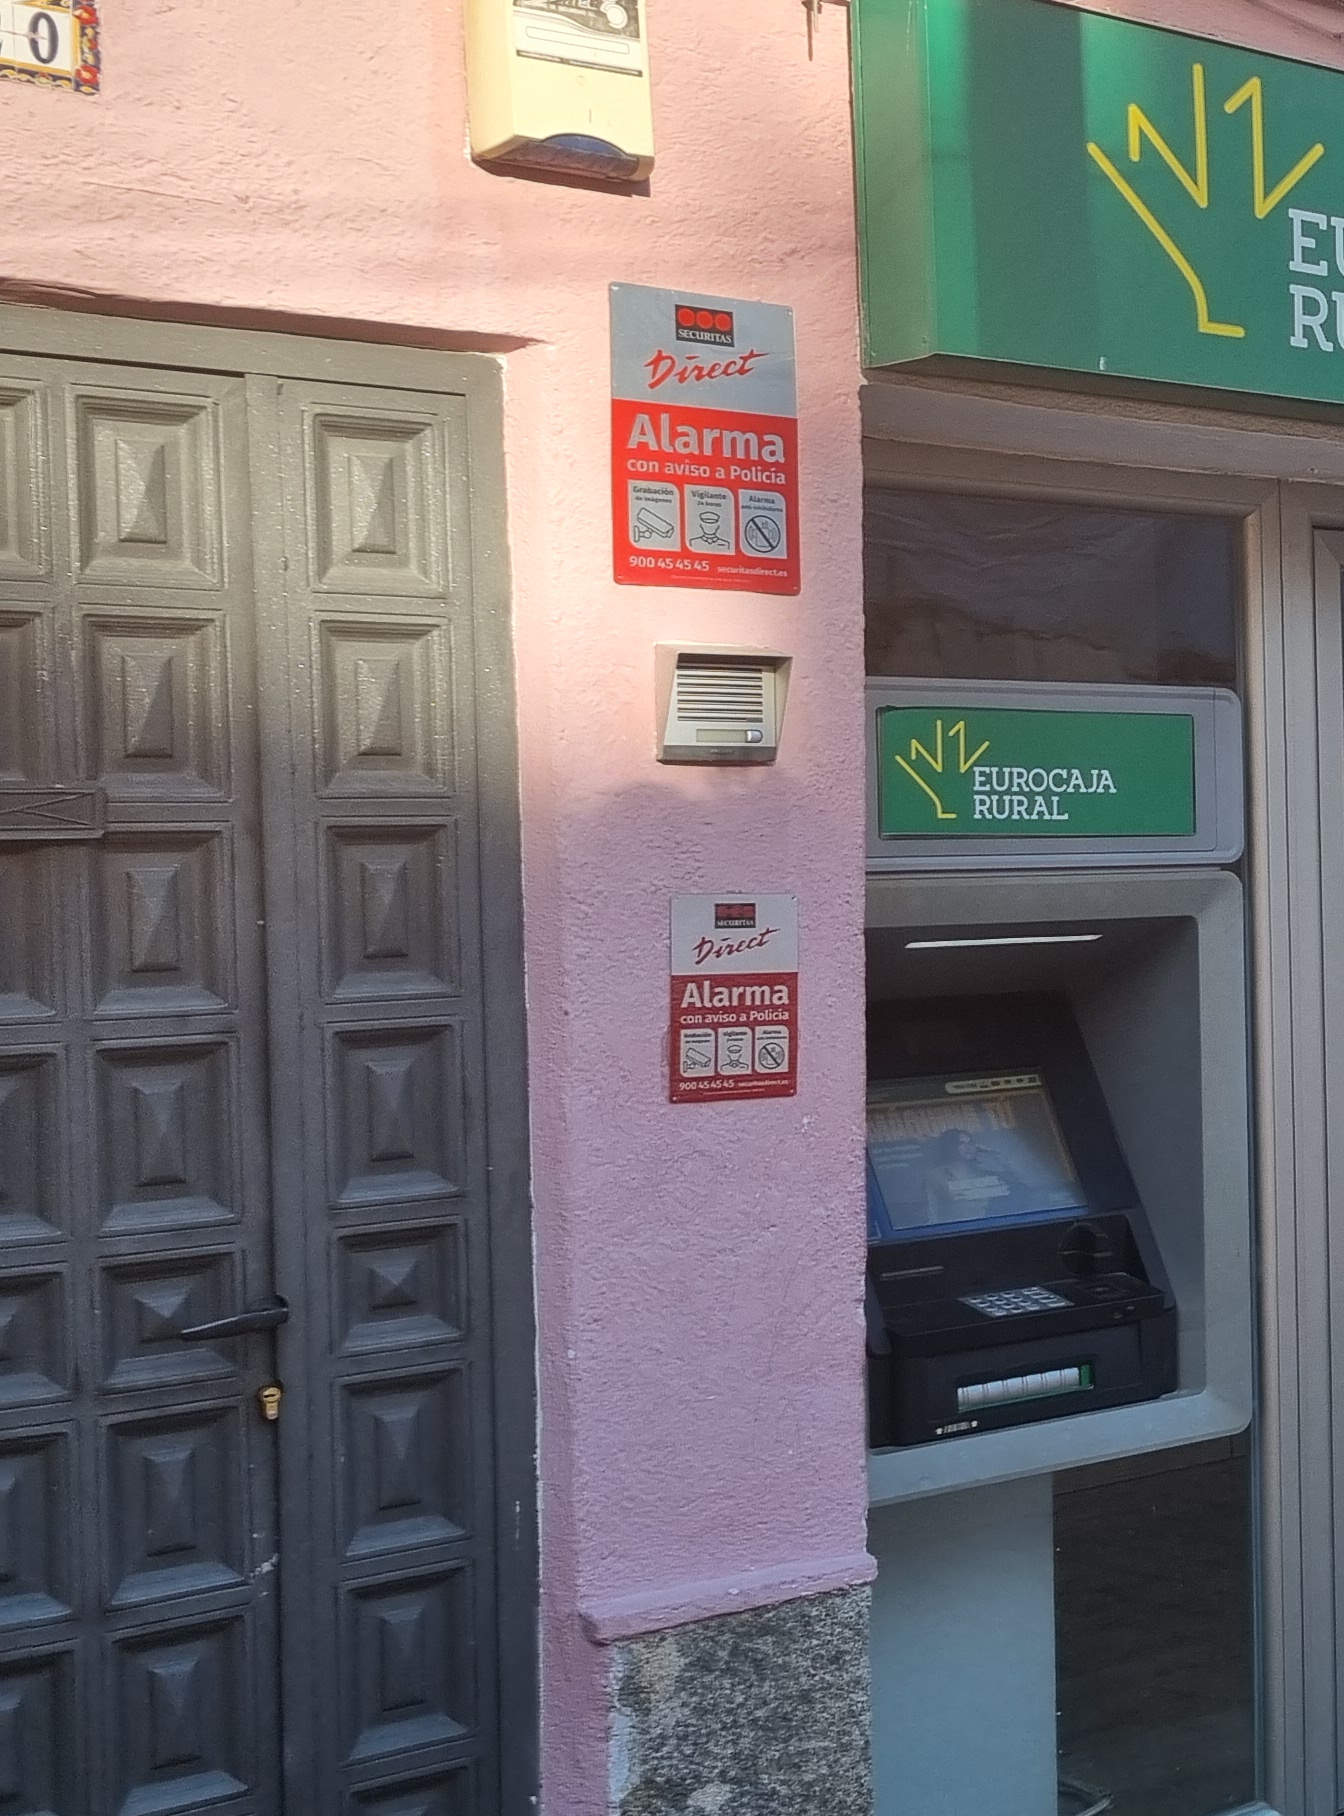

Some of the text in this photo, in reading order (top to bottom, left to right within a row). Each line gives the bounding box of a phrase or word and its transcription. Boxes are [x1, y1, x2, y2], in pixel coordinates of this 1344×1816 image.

[677, 328, 732, 344] SECURITAS
[643, 348, 770, 390] Direct
[626, 412, 786, 464] Alarma
[626, 459, 787, 486] con aviso a Policía
[691, 489, 728, 501] Vigilante
[749, 495, 776, 505] Alarma
[629, 555, 656, 568] 900
[657, 557, 674, 569] 45
[676, 559, 692, 571] 45
[694, 560, 710, 572] 45
[972, 766, 1117, 794] EUROCAJA
[973, 795, 1069, 820] RURAL
[692, 926, 780, 965] Direct
[680, 980, 790, 1008] Alarma
[680, 1008, 789, 1025] con aviso a Policía
[679, 1081, 697, 1091] 900
[698, 1080, 710, 1089] 45
[711, 1080, 722, 1088] 45
[723, 1079, 735, 1088] 45
